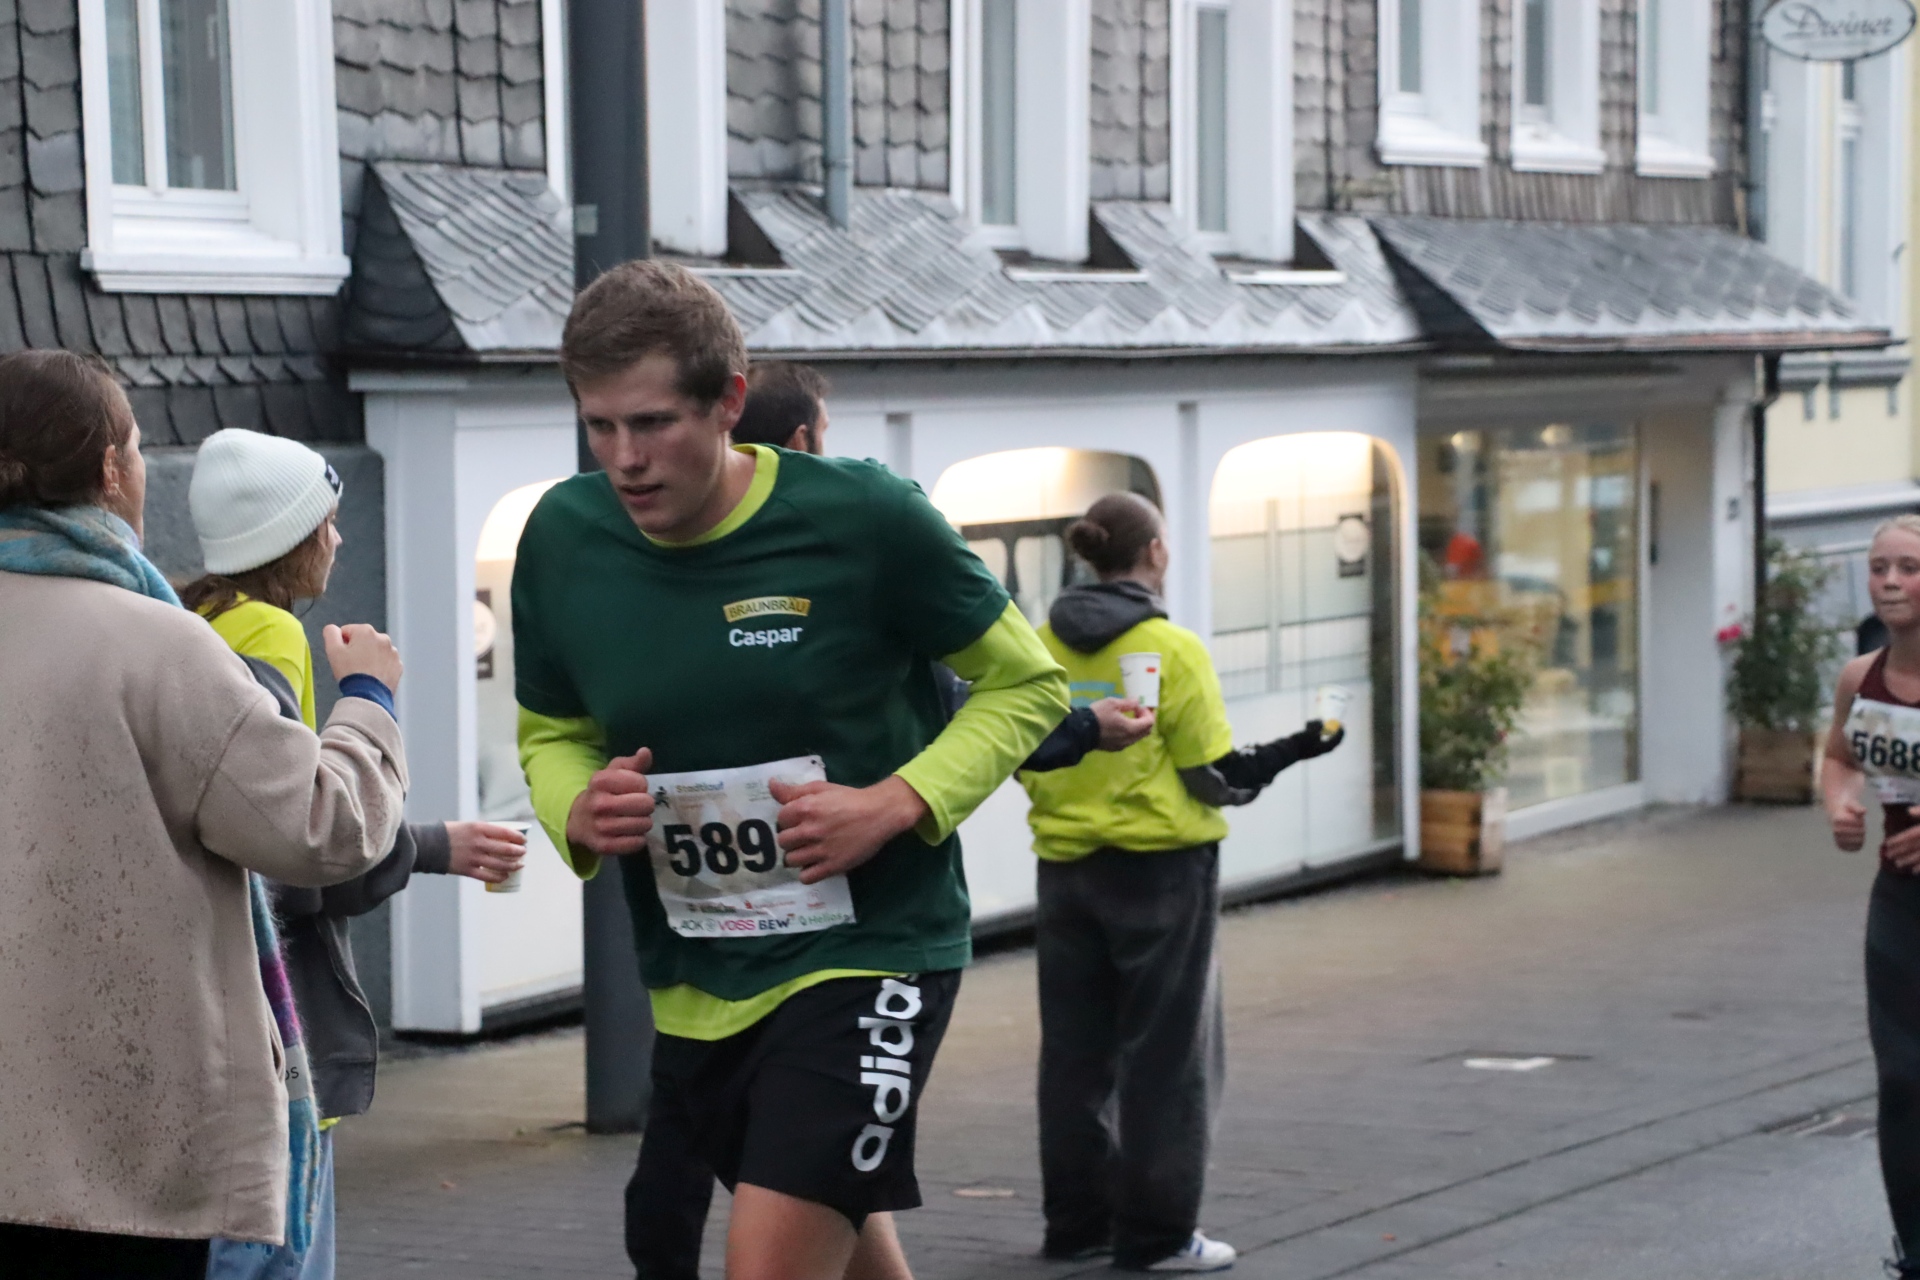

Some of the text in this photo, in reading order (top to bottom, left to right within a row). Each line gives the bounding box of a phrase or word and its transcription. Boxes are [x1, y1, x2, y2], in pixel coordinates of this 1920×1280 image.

[729, 627, 803, 648] Caspar
[718, 918, 756, 931] VOSS
[759, 918, 790, 930] BEW
[851, 974, 922, 1171] adida
